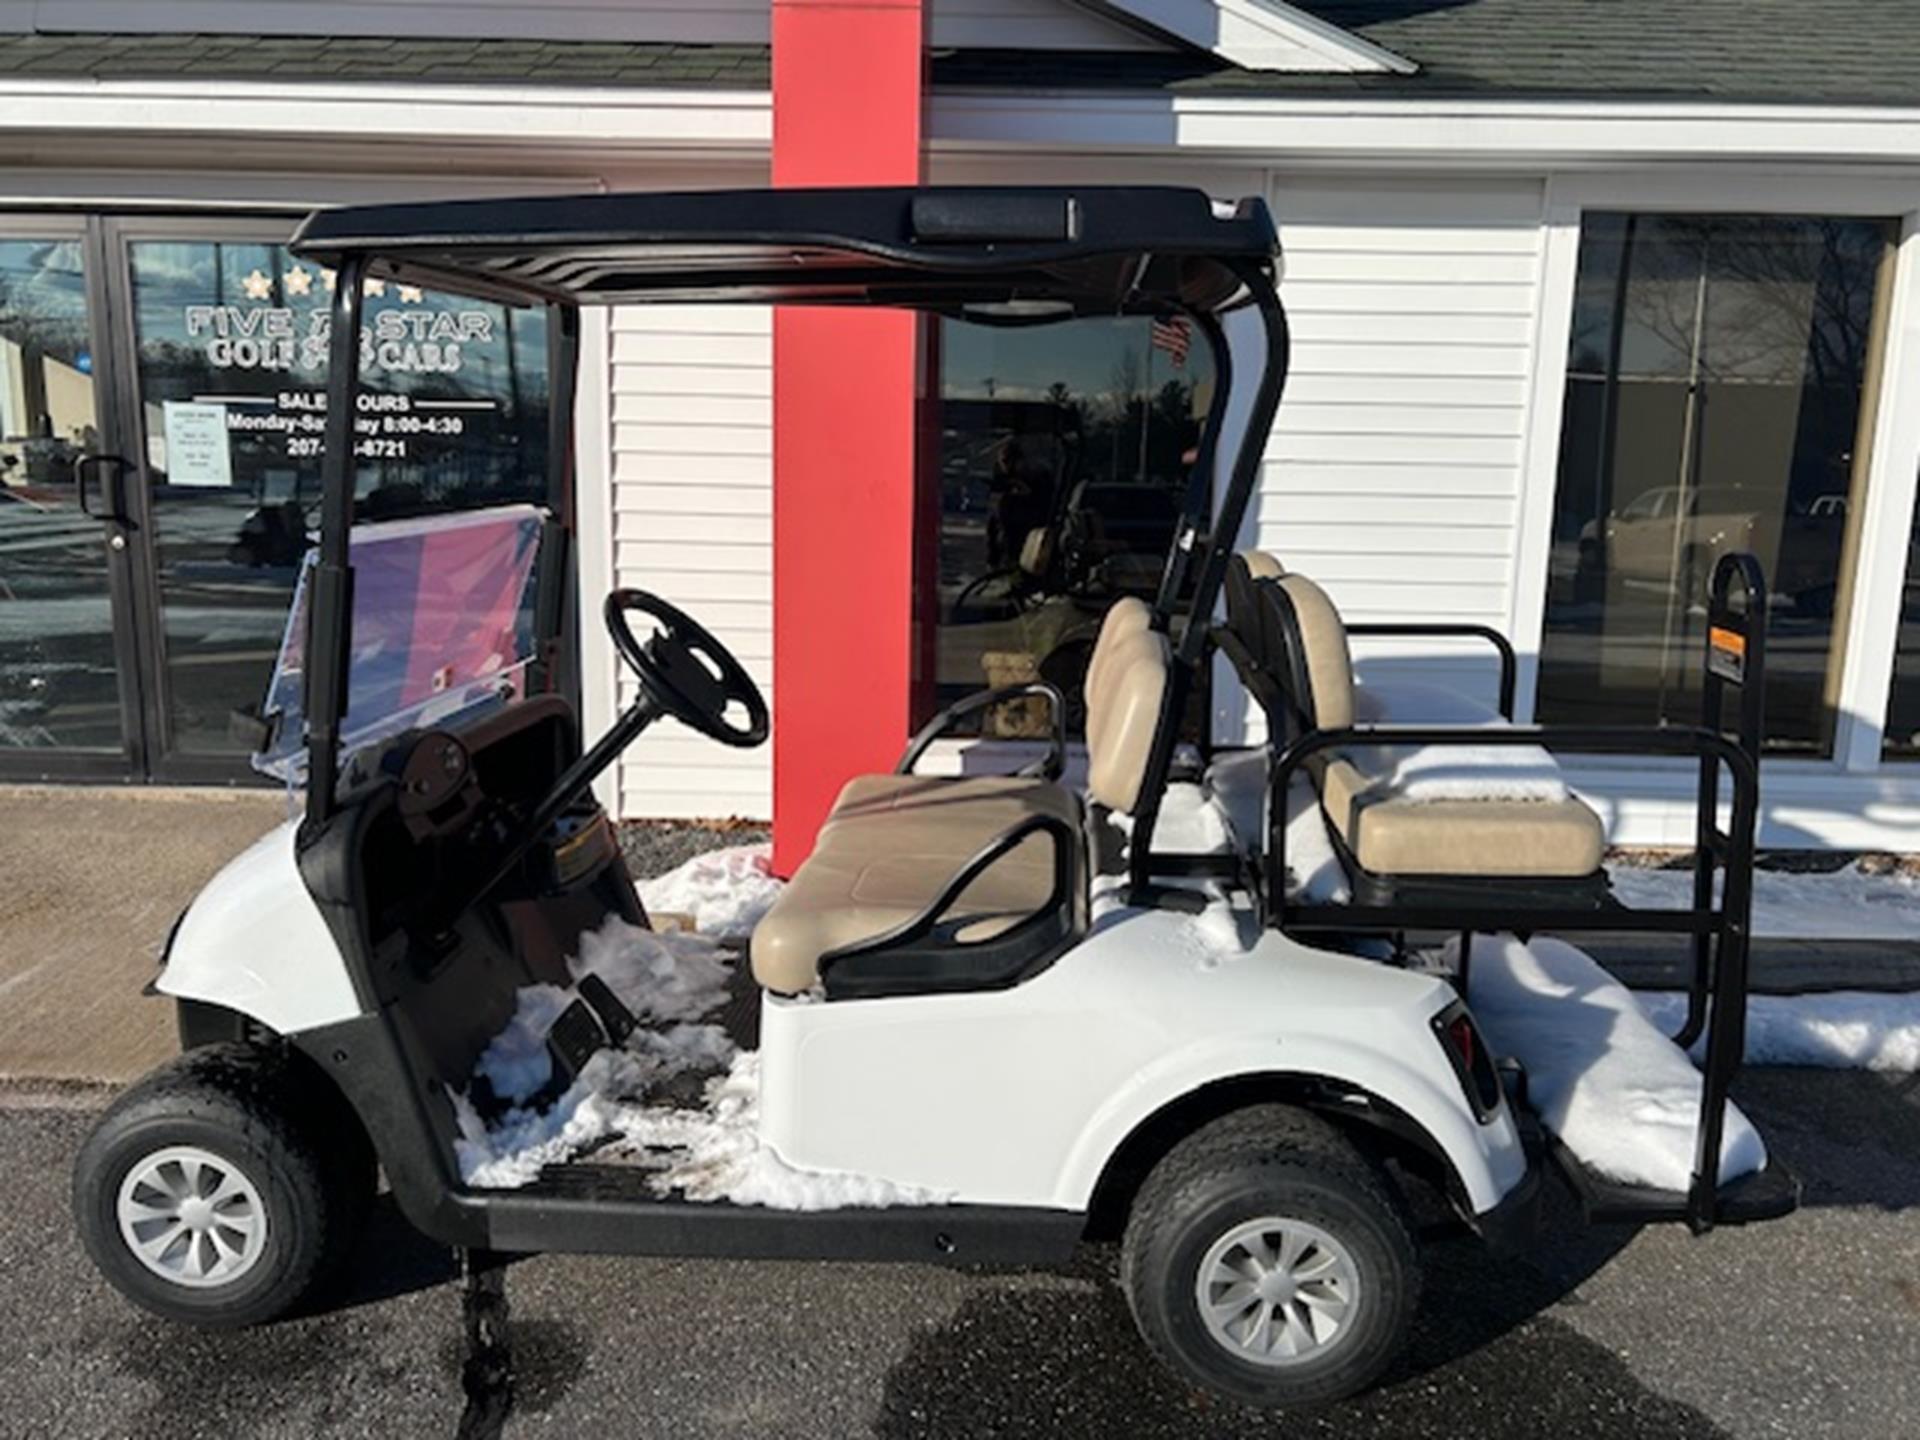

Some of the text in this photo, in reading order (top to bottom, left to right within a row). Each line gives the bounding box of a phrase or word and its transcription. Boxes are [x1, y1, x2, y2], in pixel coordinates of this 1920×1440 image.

[186, 305, 493, 342] FIVE STAR
[278, 392, 411, 413] SALE OURS
[383, 415, 463, 434] 8:00-4:30
[287, 437, 406, 457] 207--8721
